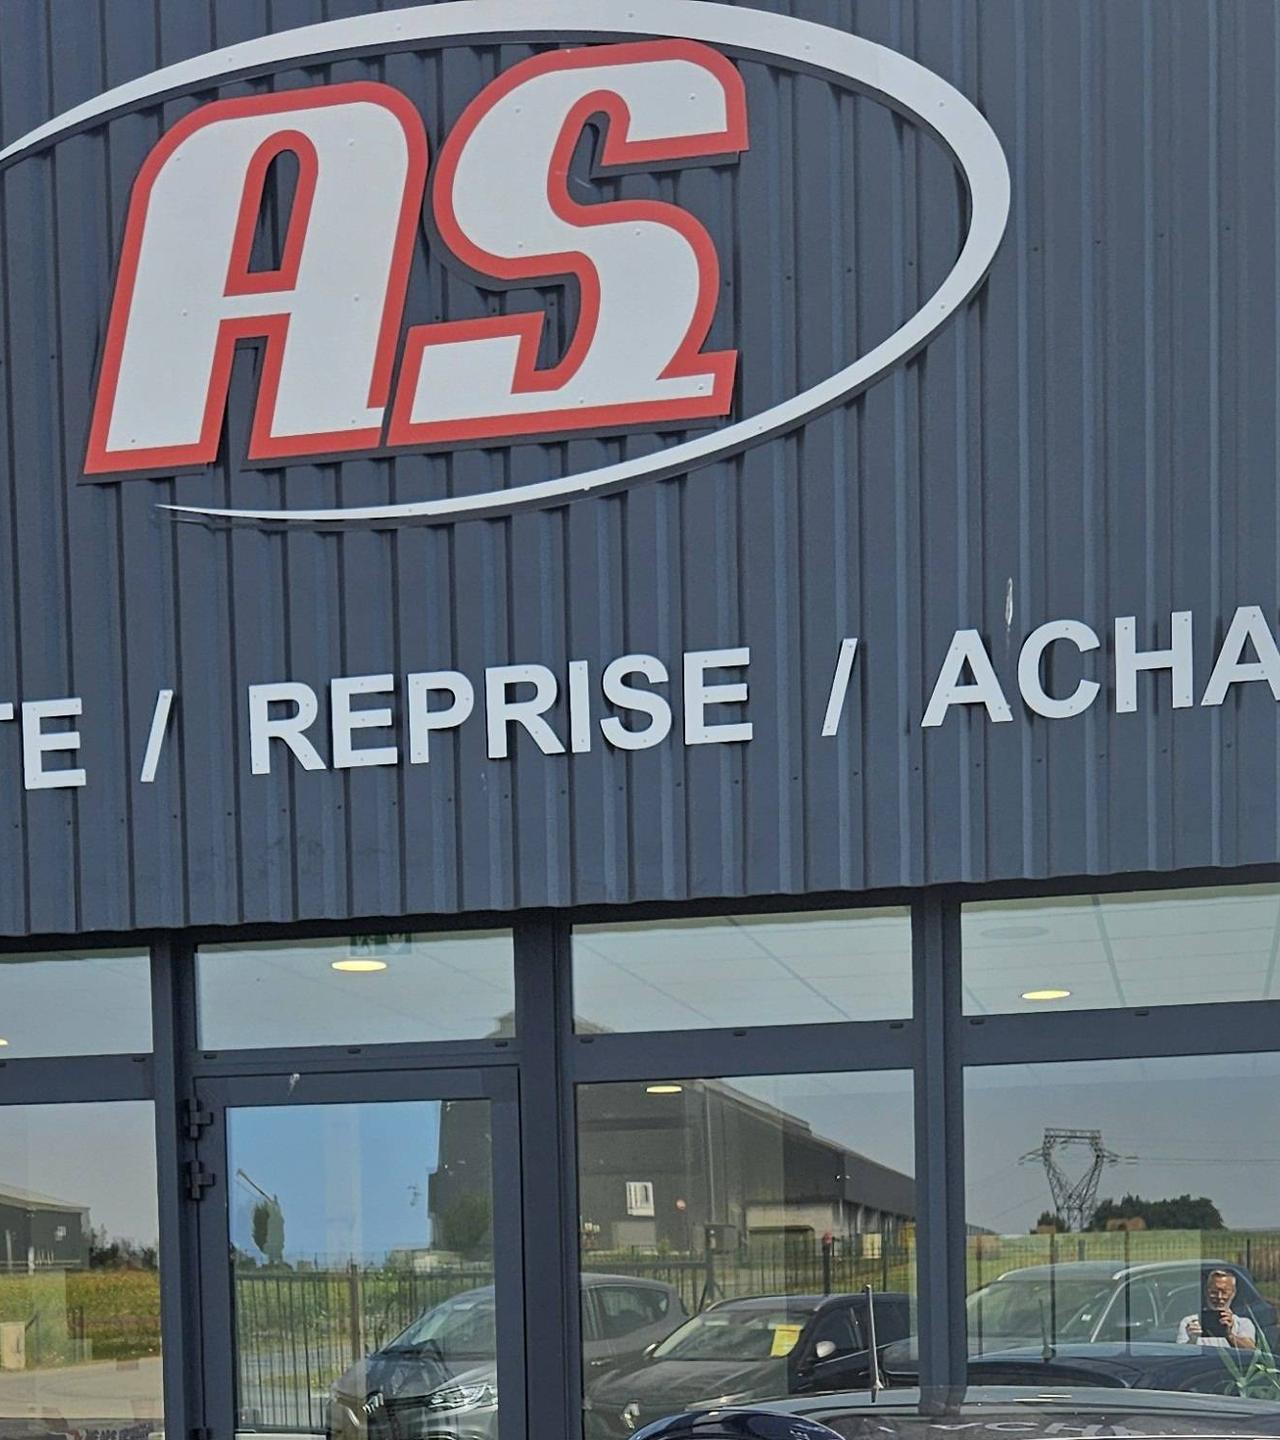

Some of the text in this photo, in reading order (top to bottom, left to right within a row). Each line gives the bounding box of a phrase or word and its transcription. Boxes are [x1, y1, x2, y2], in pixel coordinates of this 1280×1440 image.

[84, 39, 749, 475] AS
[140, 689, 174, 783] /
[247, 647, 754, 776] REPRISE
[821, 636, 859, 738] /
